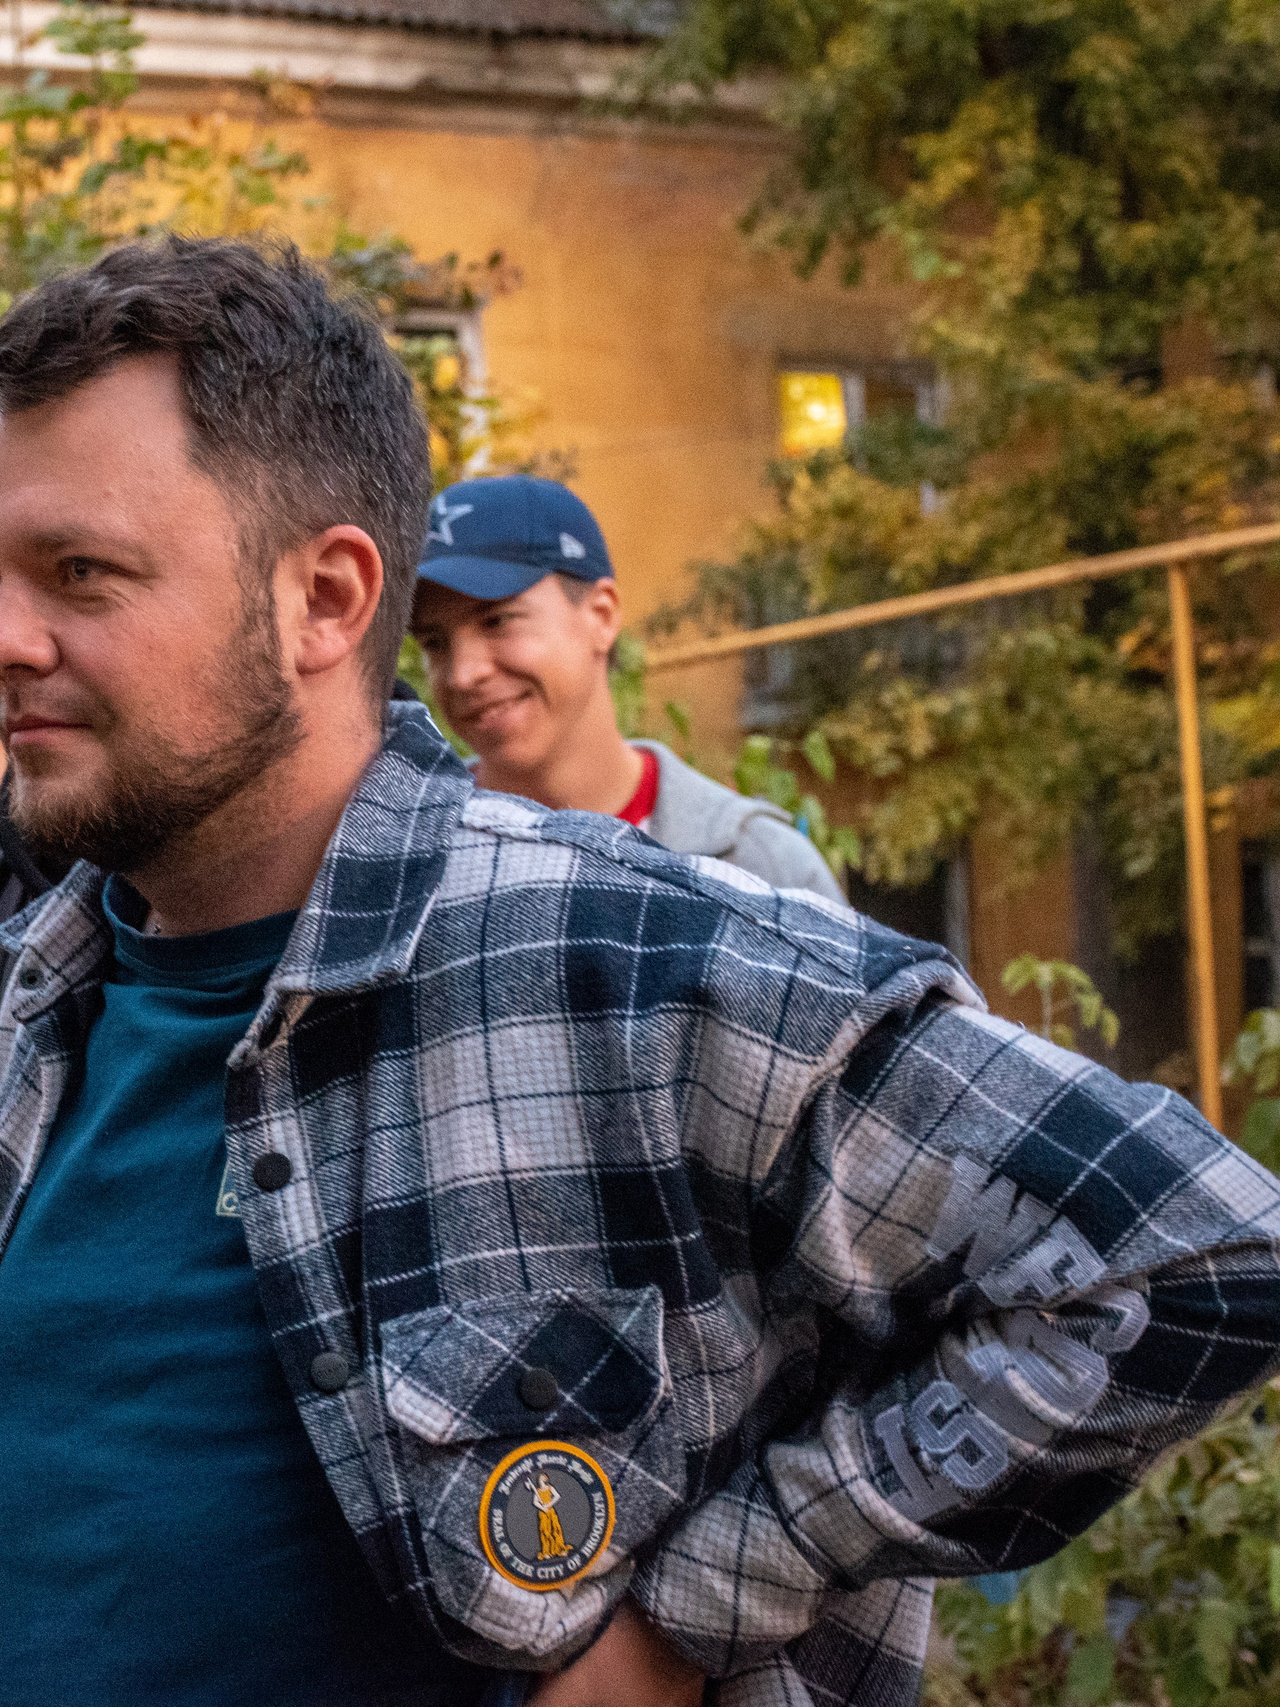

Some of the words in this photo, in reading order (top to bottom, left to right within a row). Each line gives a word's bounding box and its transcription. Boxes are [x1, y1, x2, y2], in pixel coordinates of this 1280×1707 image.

[491, 1508, 505, 1543] SEAL
[510, 1559, 535, 1579] THE
[536, 1565, 565, 1580] CITY
[567, 1556, 583, 1571] OF
[581, 1491, 607, 1558] BROOKLYN
